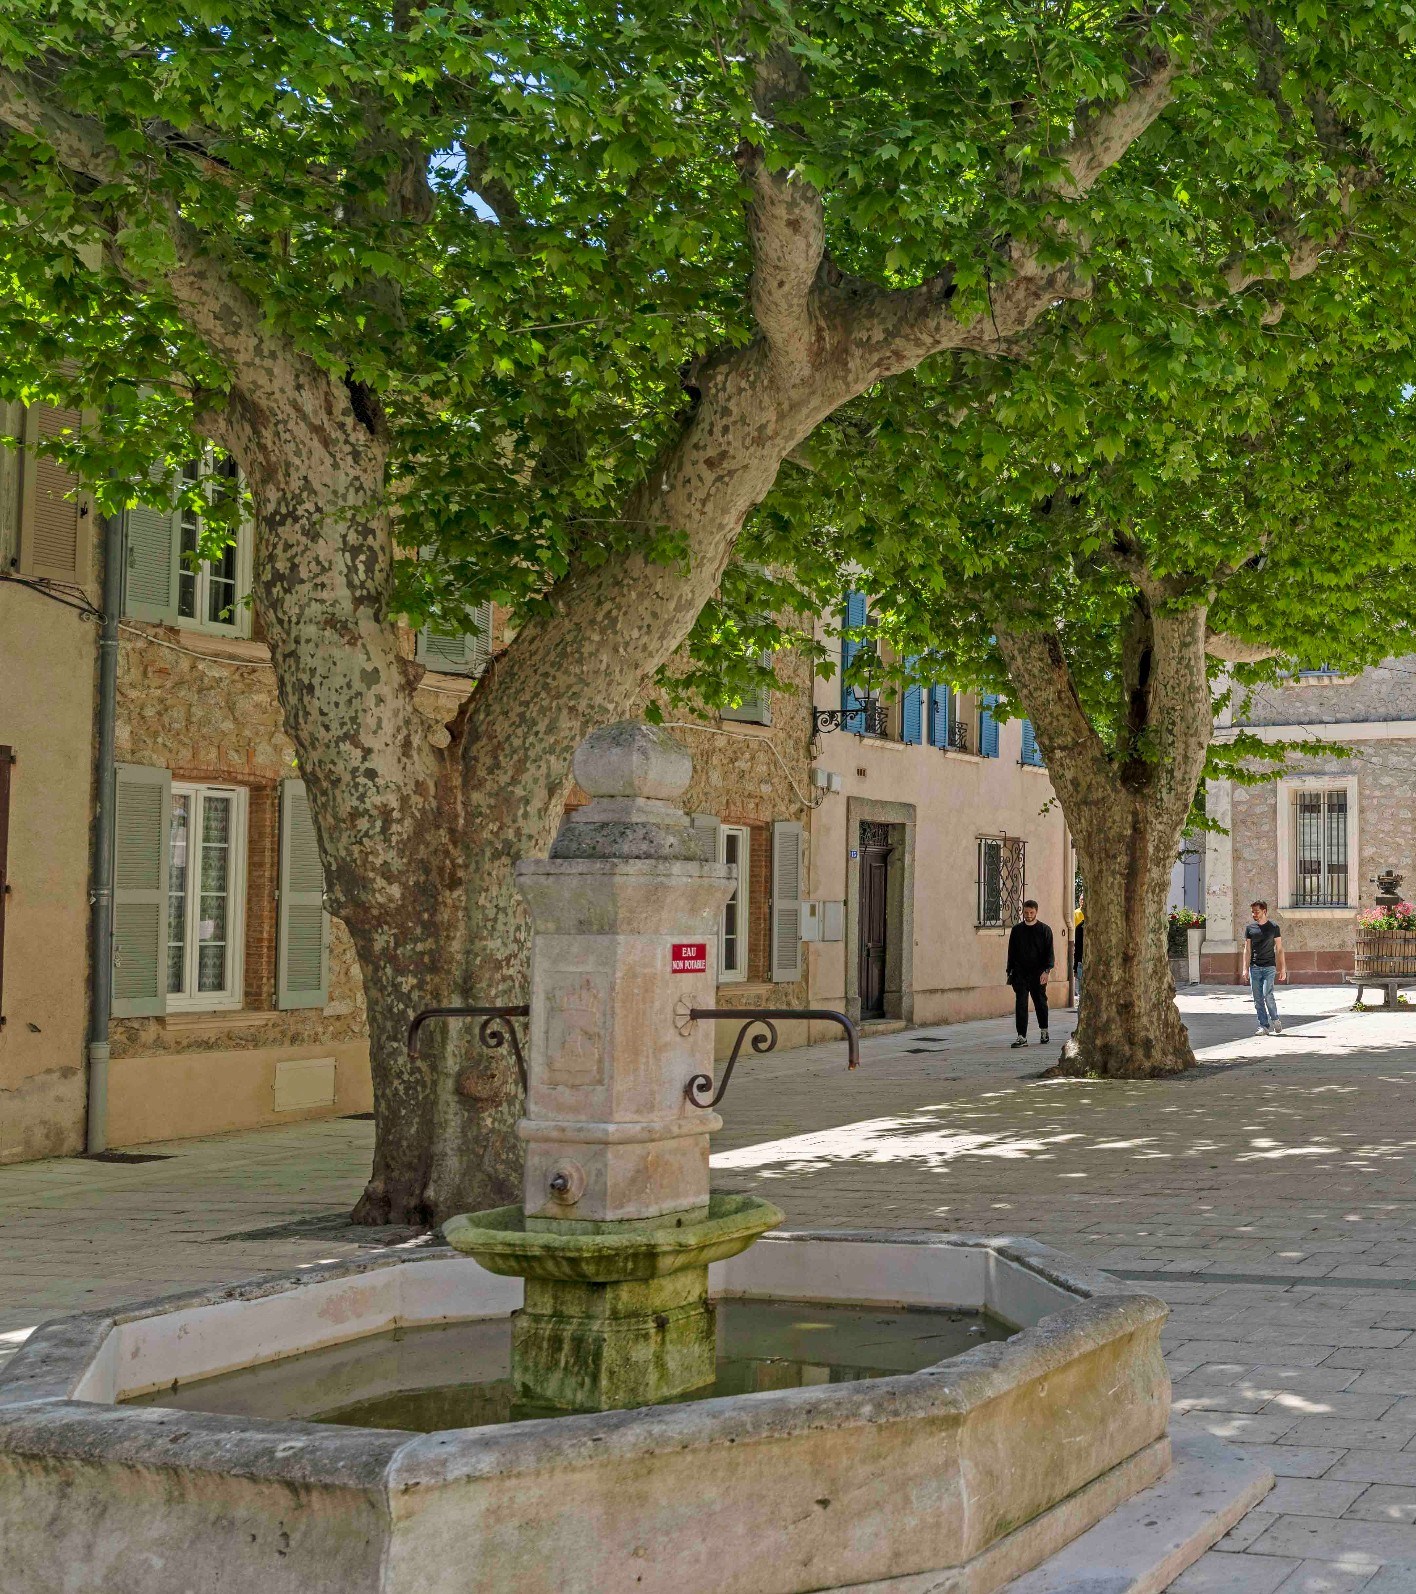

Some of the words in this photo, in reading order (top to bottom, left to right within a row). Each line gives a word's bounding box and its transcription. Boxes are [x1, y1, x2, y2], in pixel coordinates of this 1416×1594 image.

[682, 947, 697, 957] EAU
[672, 960, 684, 969] NON
[685, 960, 705, 969] POTABLE
